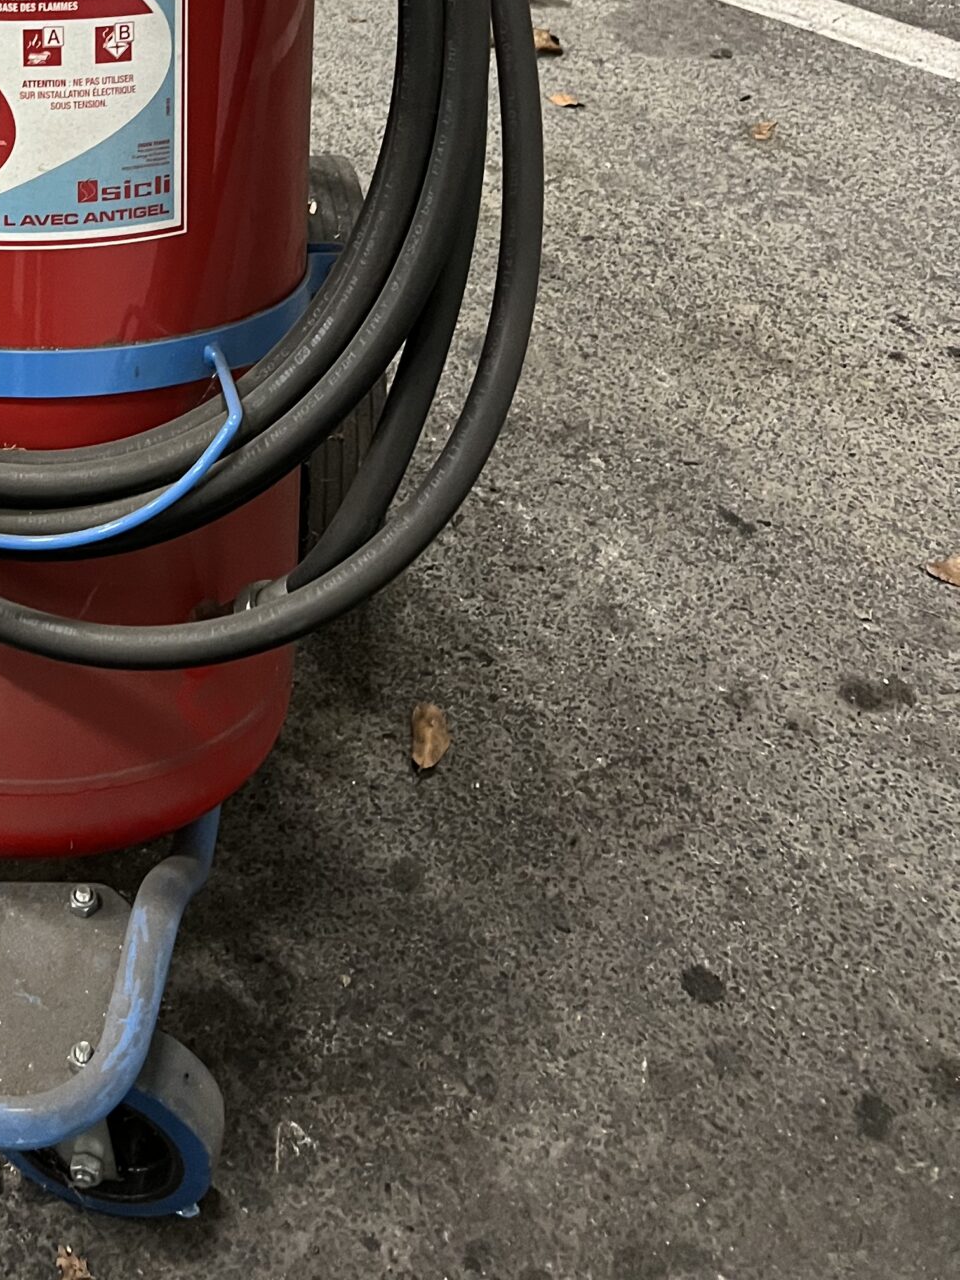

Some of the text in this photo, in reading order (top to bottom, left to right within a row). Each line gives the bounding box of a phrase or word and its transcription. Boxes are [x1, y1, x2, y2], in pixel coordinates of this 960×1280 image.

[20, 2, 36, 12] DES
[38, 1, 78, 12] FLAMMES
[47, 29, 60, 44] A
[119, 25, 131, 40] B
[22, 79, 67, 88] ATTENTION
[73, 78, 83, 87] NE
[85, 77, 100, 86] PAS
[102, 74, 134, 85] UTILISER
[20, 85, 136, 100] SUR INSTALLATION ÉLECTRIQUE
[50, 99, 107, 110] SOUS TENSION.
[101, 174, 170, 202] sicli
[4, 215, 16, 226] L
[19, 212, 79, 227] AVEC
[83, 203, 170, 224] ANTIGEL
